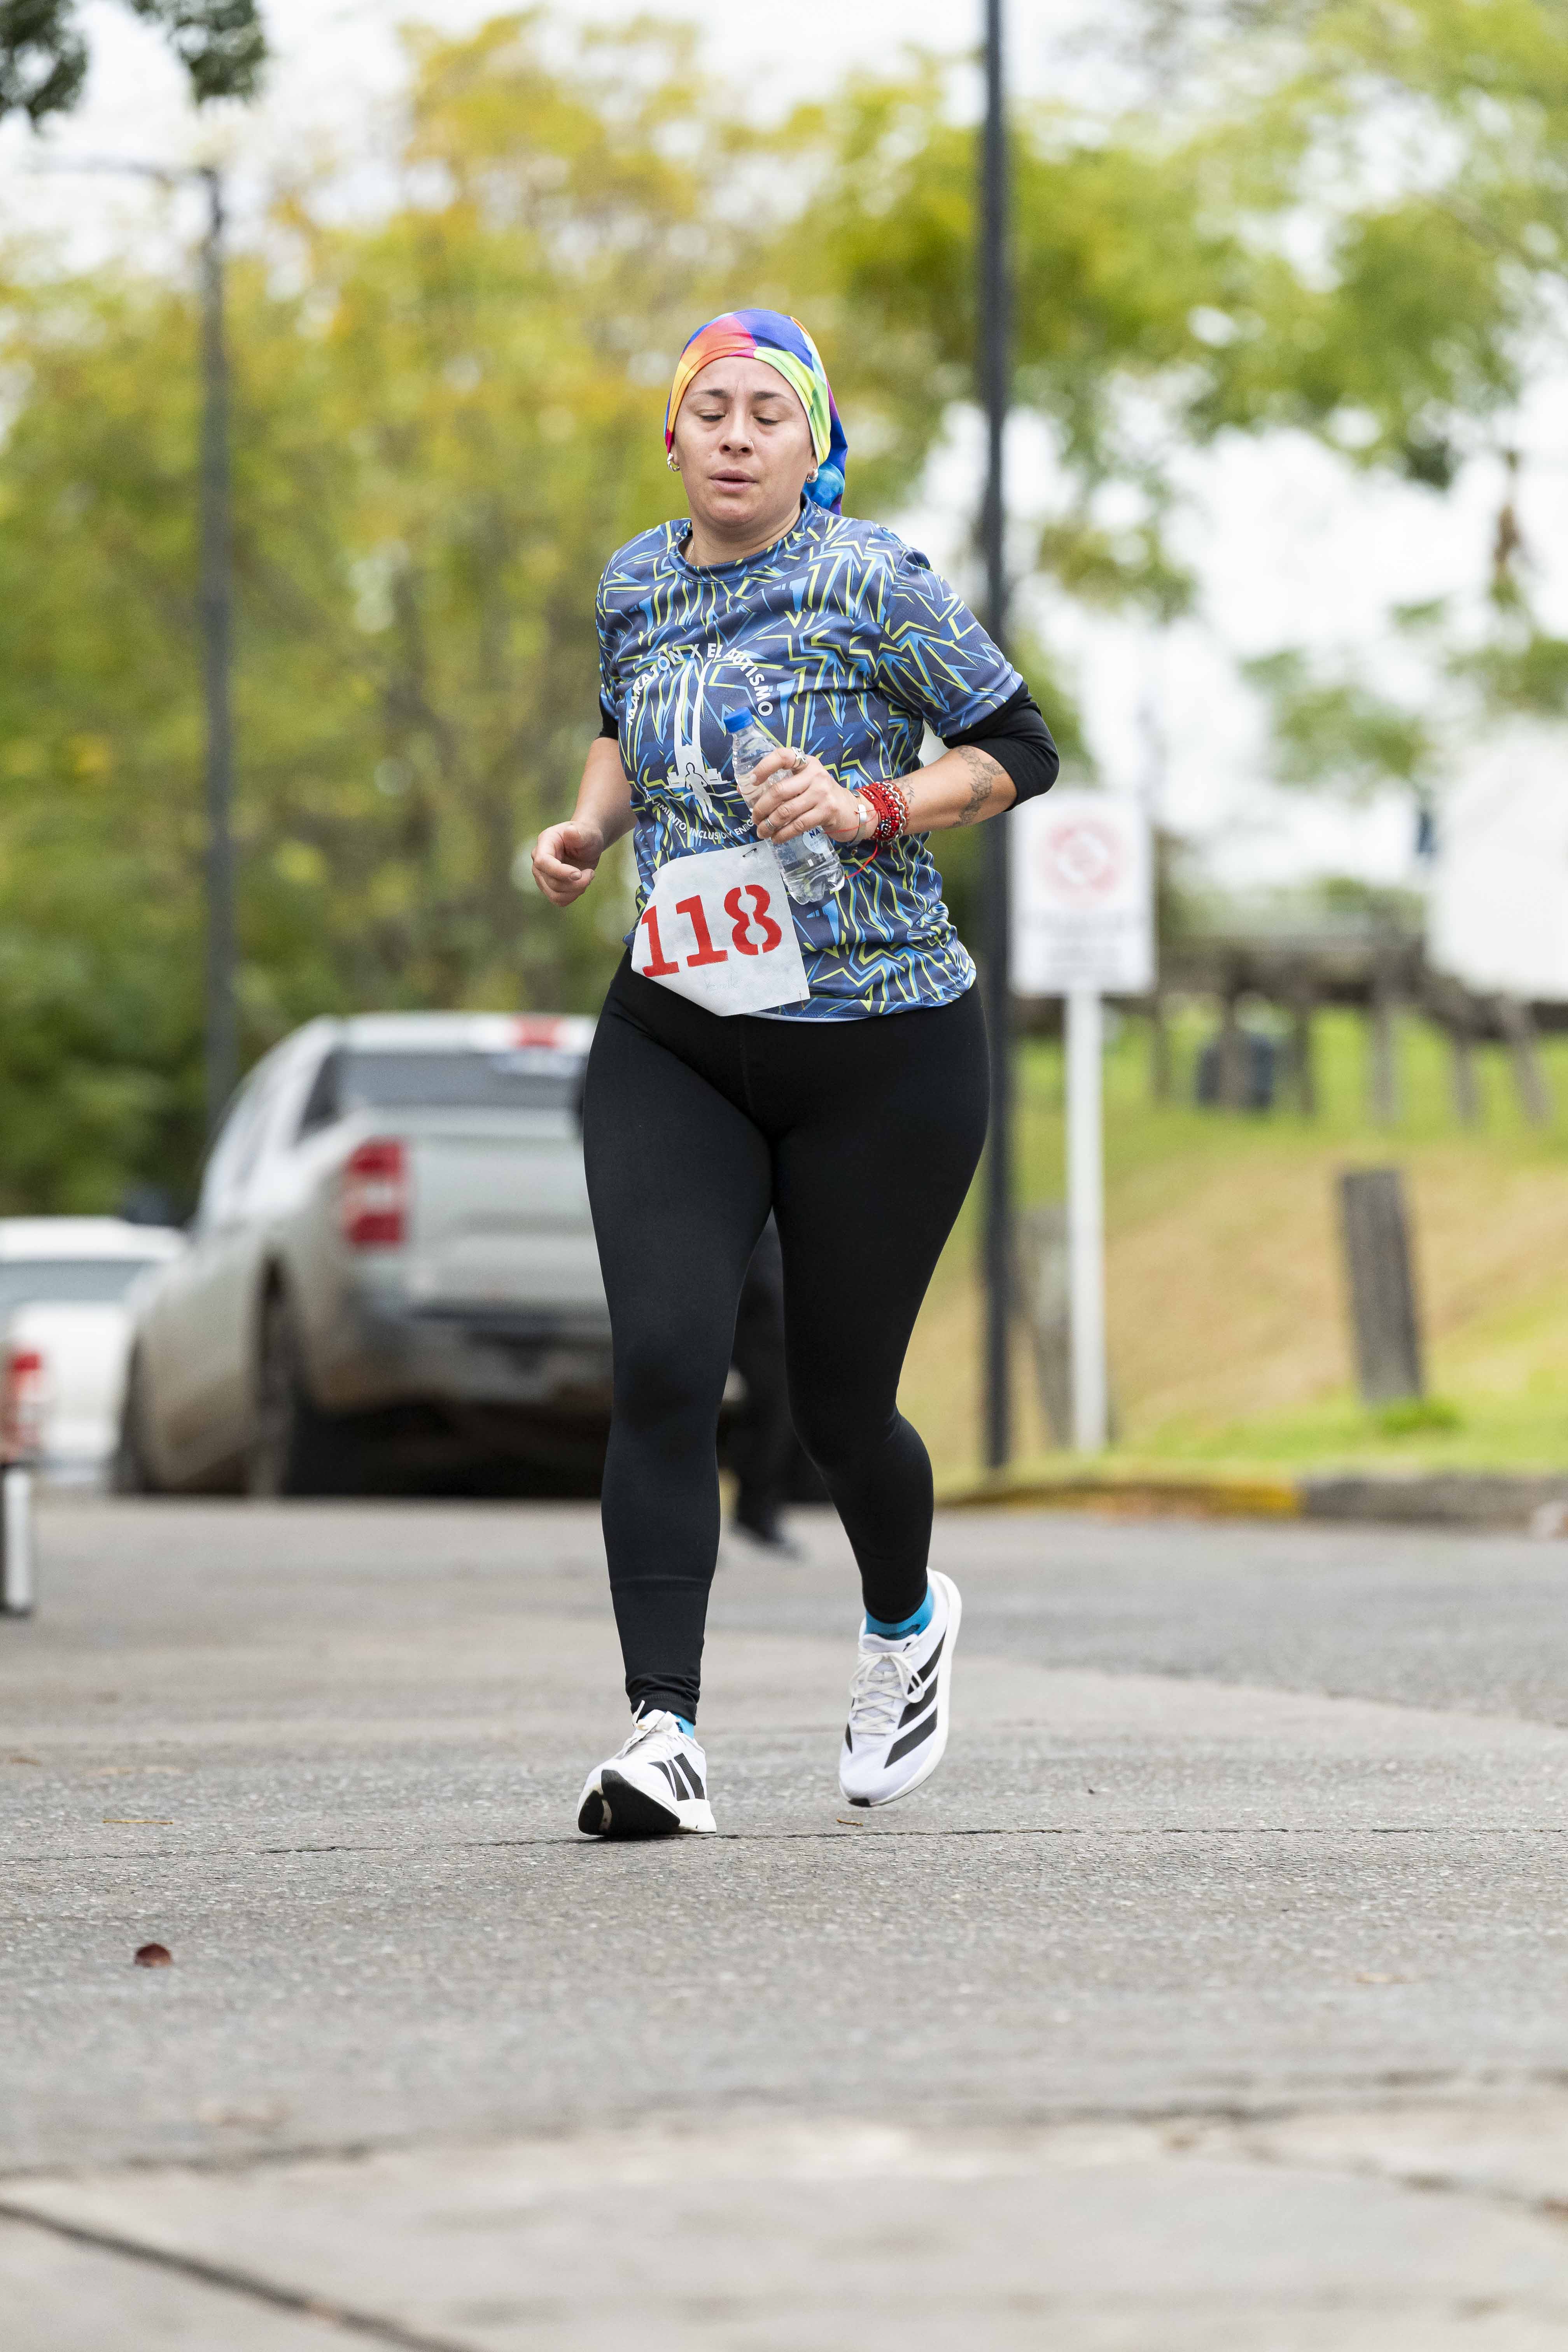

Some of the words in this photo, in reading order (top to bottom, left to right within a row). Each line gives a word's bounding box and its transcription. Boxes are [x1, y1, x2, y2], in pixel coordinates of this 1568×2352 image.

[688, 644, 702, 658] X
[707, 643, 723, 658] EL
[723, 648, 773, 716] AUTISMO
[641, 884, 782, 978] 118
